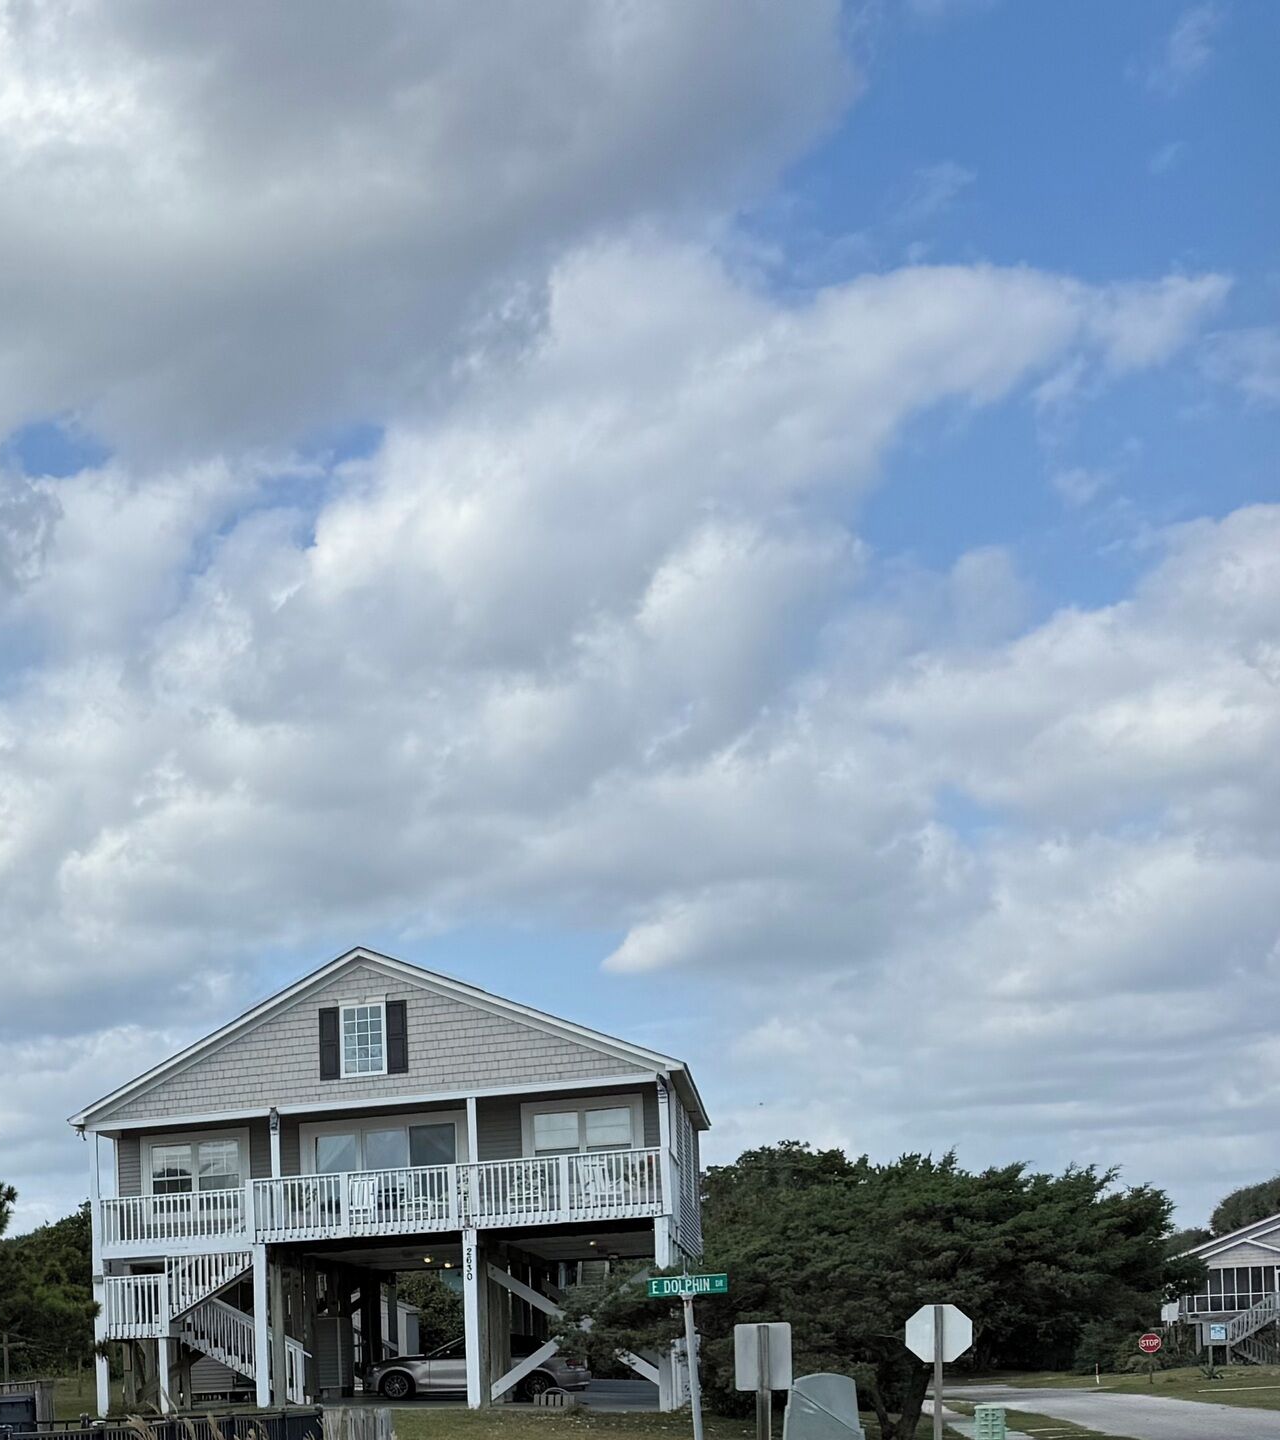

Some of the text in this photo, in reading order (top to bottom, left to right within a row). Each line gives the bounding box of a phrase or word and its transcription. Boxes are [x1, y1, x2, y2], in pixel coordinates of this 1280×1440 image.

[652, 1281, 659, 1294] E
[664, 1278, 710, 1294] DOLPHIN
[1141, 1338, 1159, 1347] STOP
